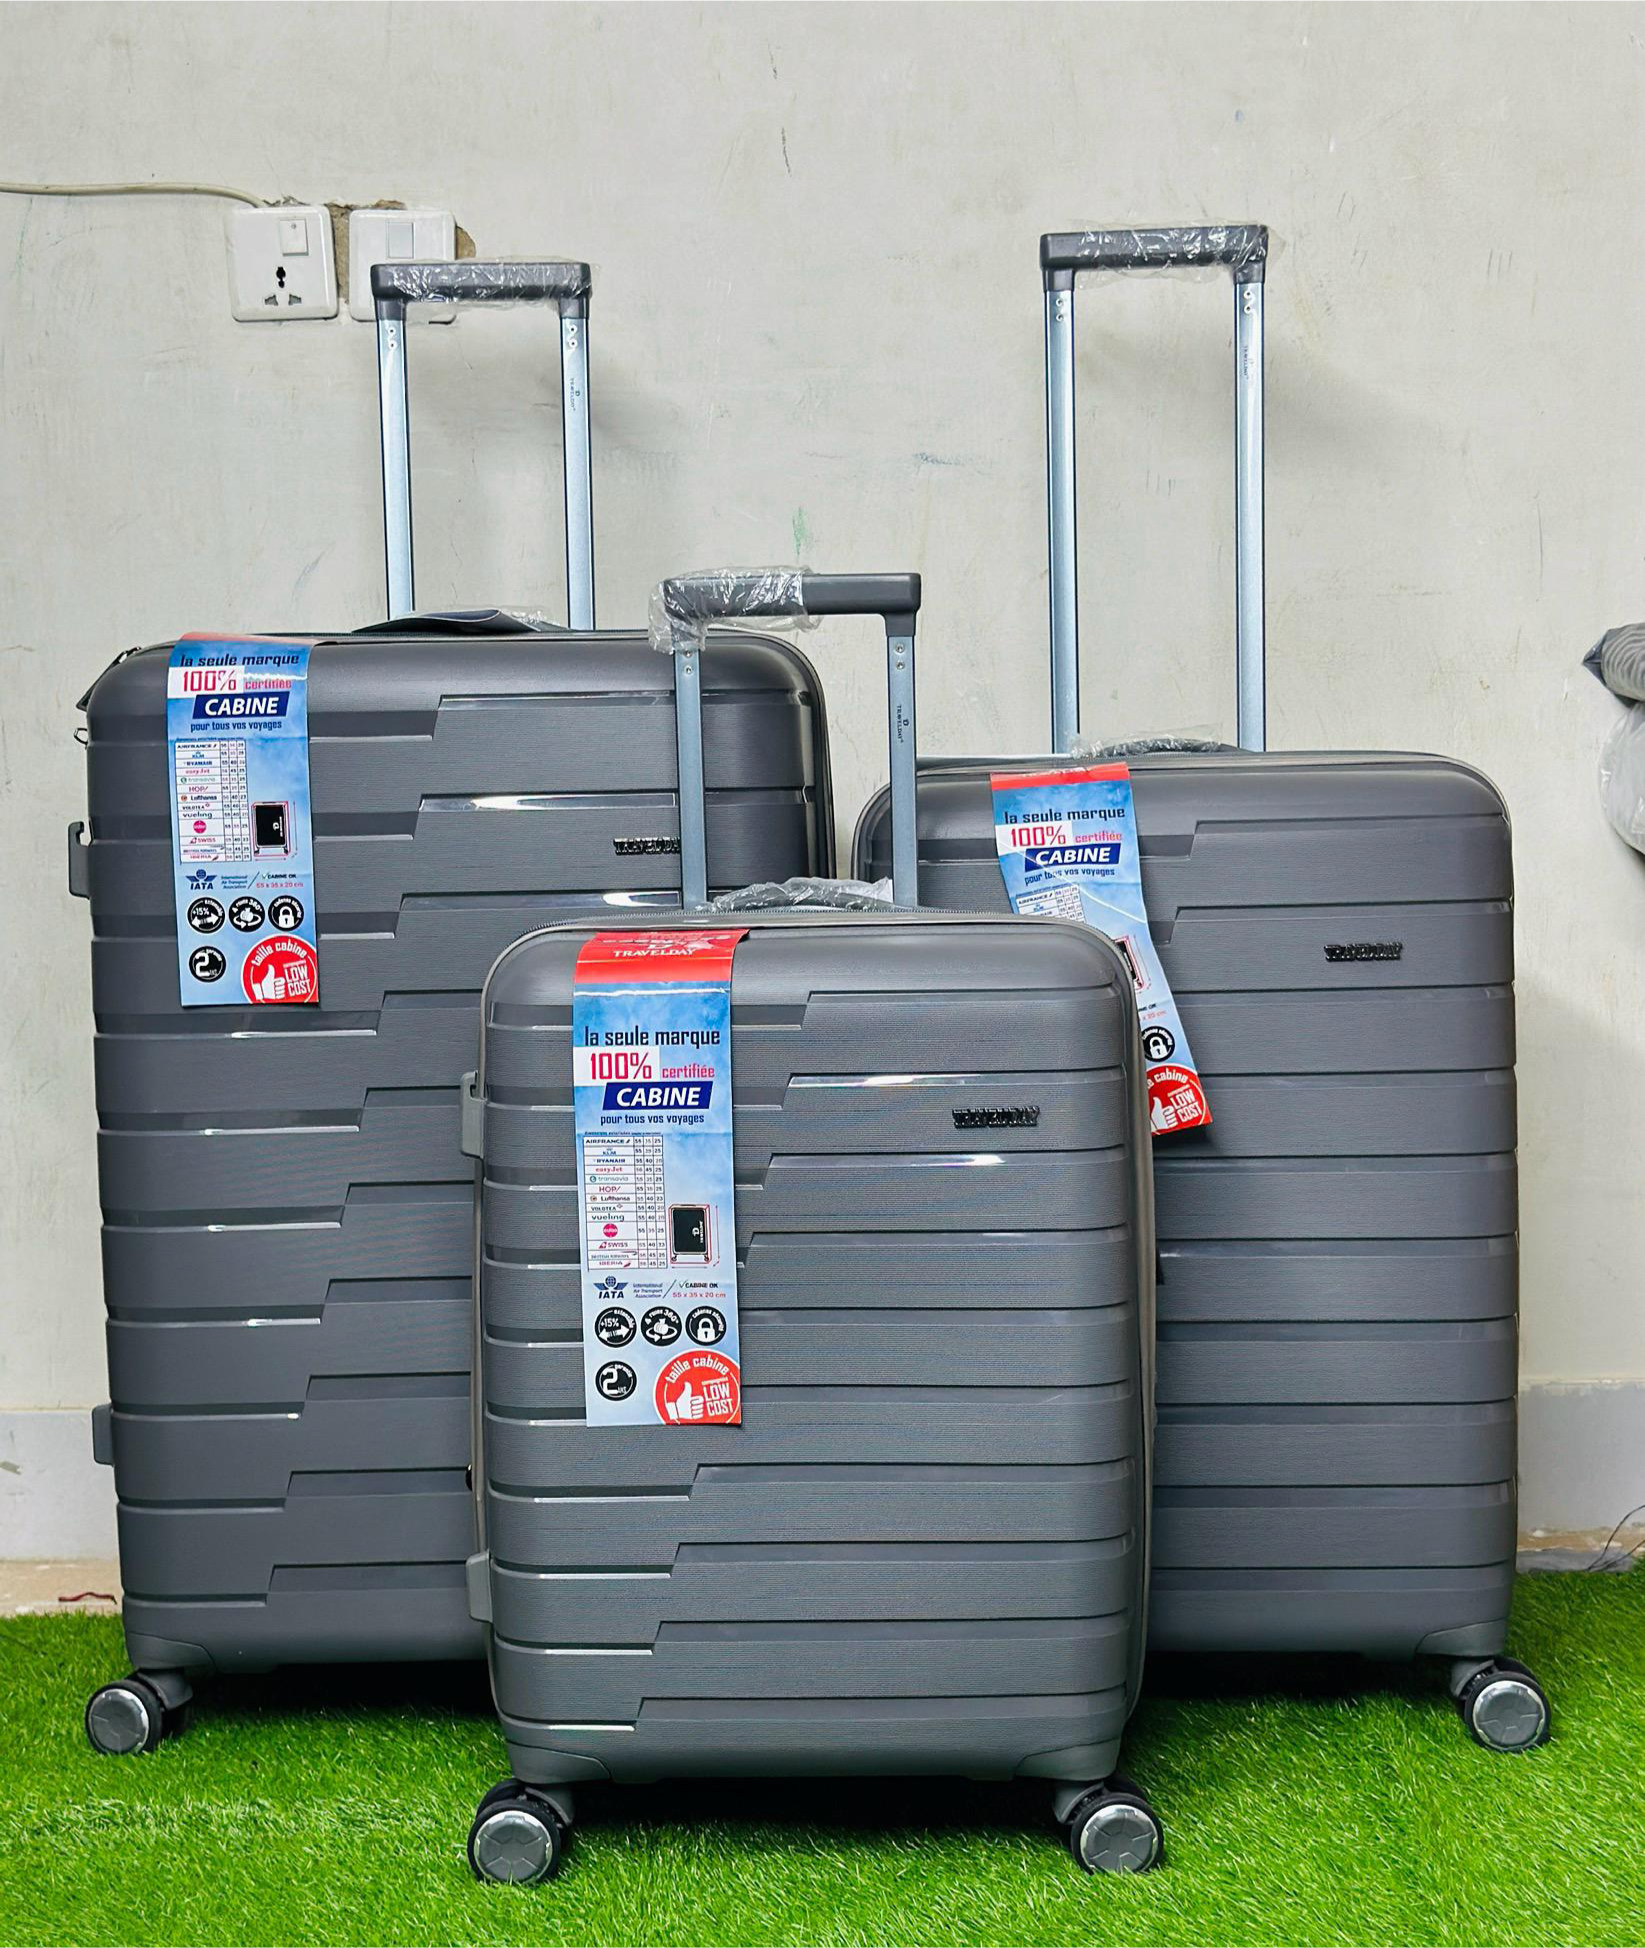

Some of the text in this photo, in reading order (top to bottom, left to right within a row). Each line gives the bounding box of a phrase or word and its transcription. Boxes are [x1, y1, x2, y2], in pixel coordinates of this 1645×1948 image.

[180, 654, 299, 667] la seule marque
[184, 670, 237, 692] 100%
[205, 697, 279, 716] CABINE
[191, 720, 282, 733] pour tous vos voyages
[1005, 808, 1125, 824] la seule marque
[1011, 825, 1122, 847] 100% certifiée
[1036, 847, 1111, 866] CABINE
[1025, 873, 1042, 886] pour
[1082, 868, 1115, 877] voyages
[251, 939, 308, 966] taille cabine
[614, 948, 697, 957] TRAVELDAY
[195, 953, 210, 977] 2
[285, 964, 309, 983] LOW
[288, 979, 311, 997] COST
[585, 1025, 720, 1049] la seule marque
[591, 1052, 715, 1080] 100% certifiée
[1154, 1067, 1188, 1083] cabine
[616, 1087, 701, 1107] CABINE
[1170, 1089, 1196, 1110] LOW
[600, 1114, 704, 1126] pour tous vos voyages
[1177, 1101, 1202, 1123] COST
[592, 1213, 624, 1222] vueling
[599, 1291, 624, 1299] IATA
[601, 1318, 619, 1328] +15%
[665, 1355, 729, 1384] taille cabine
[602, 1368, 618, 1394] 2
[703, 1384, 731, 1401] LOW
[706, 1398, 733, 1416] COST
